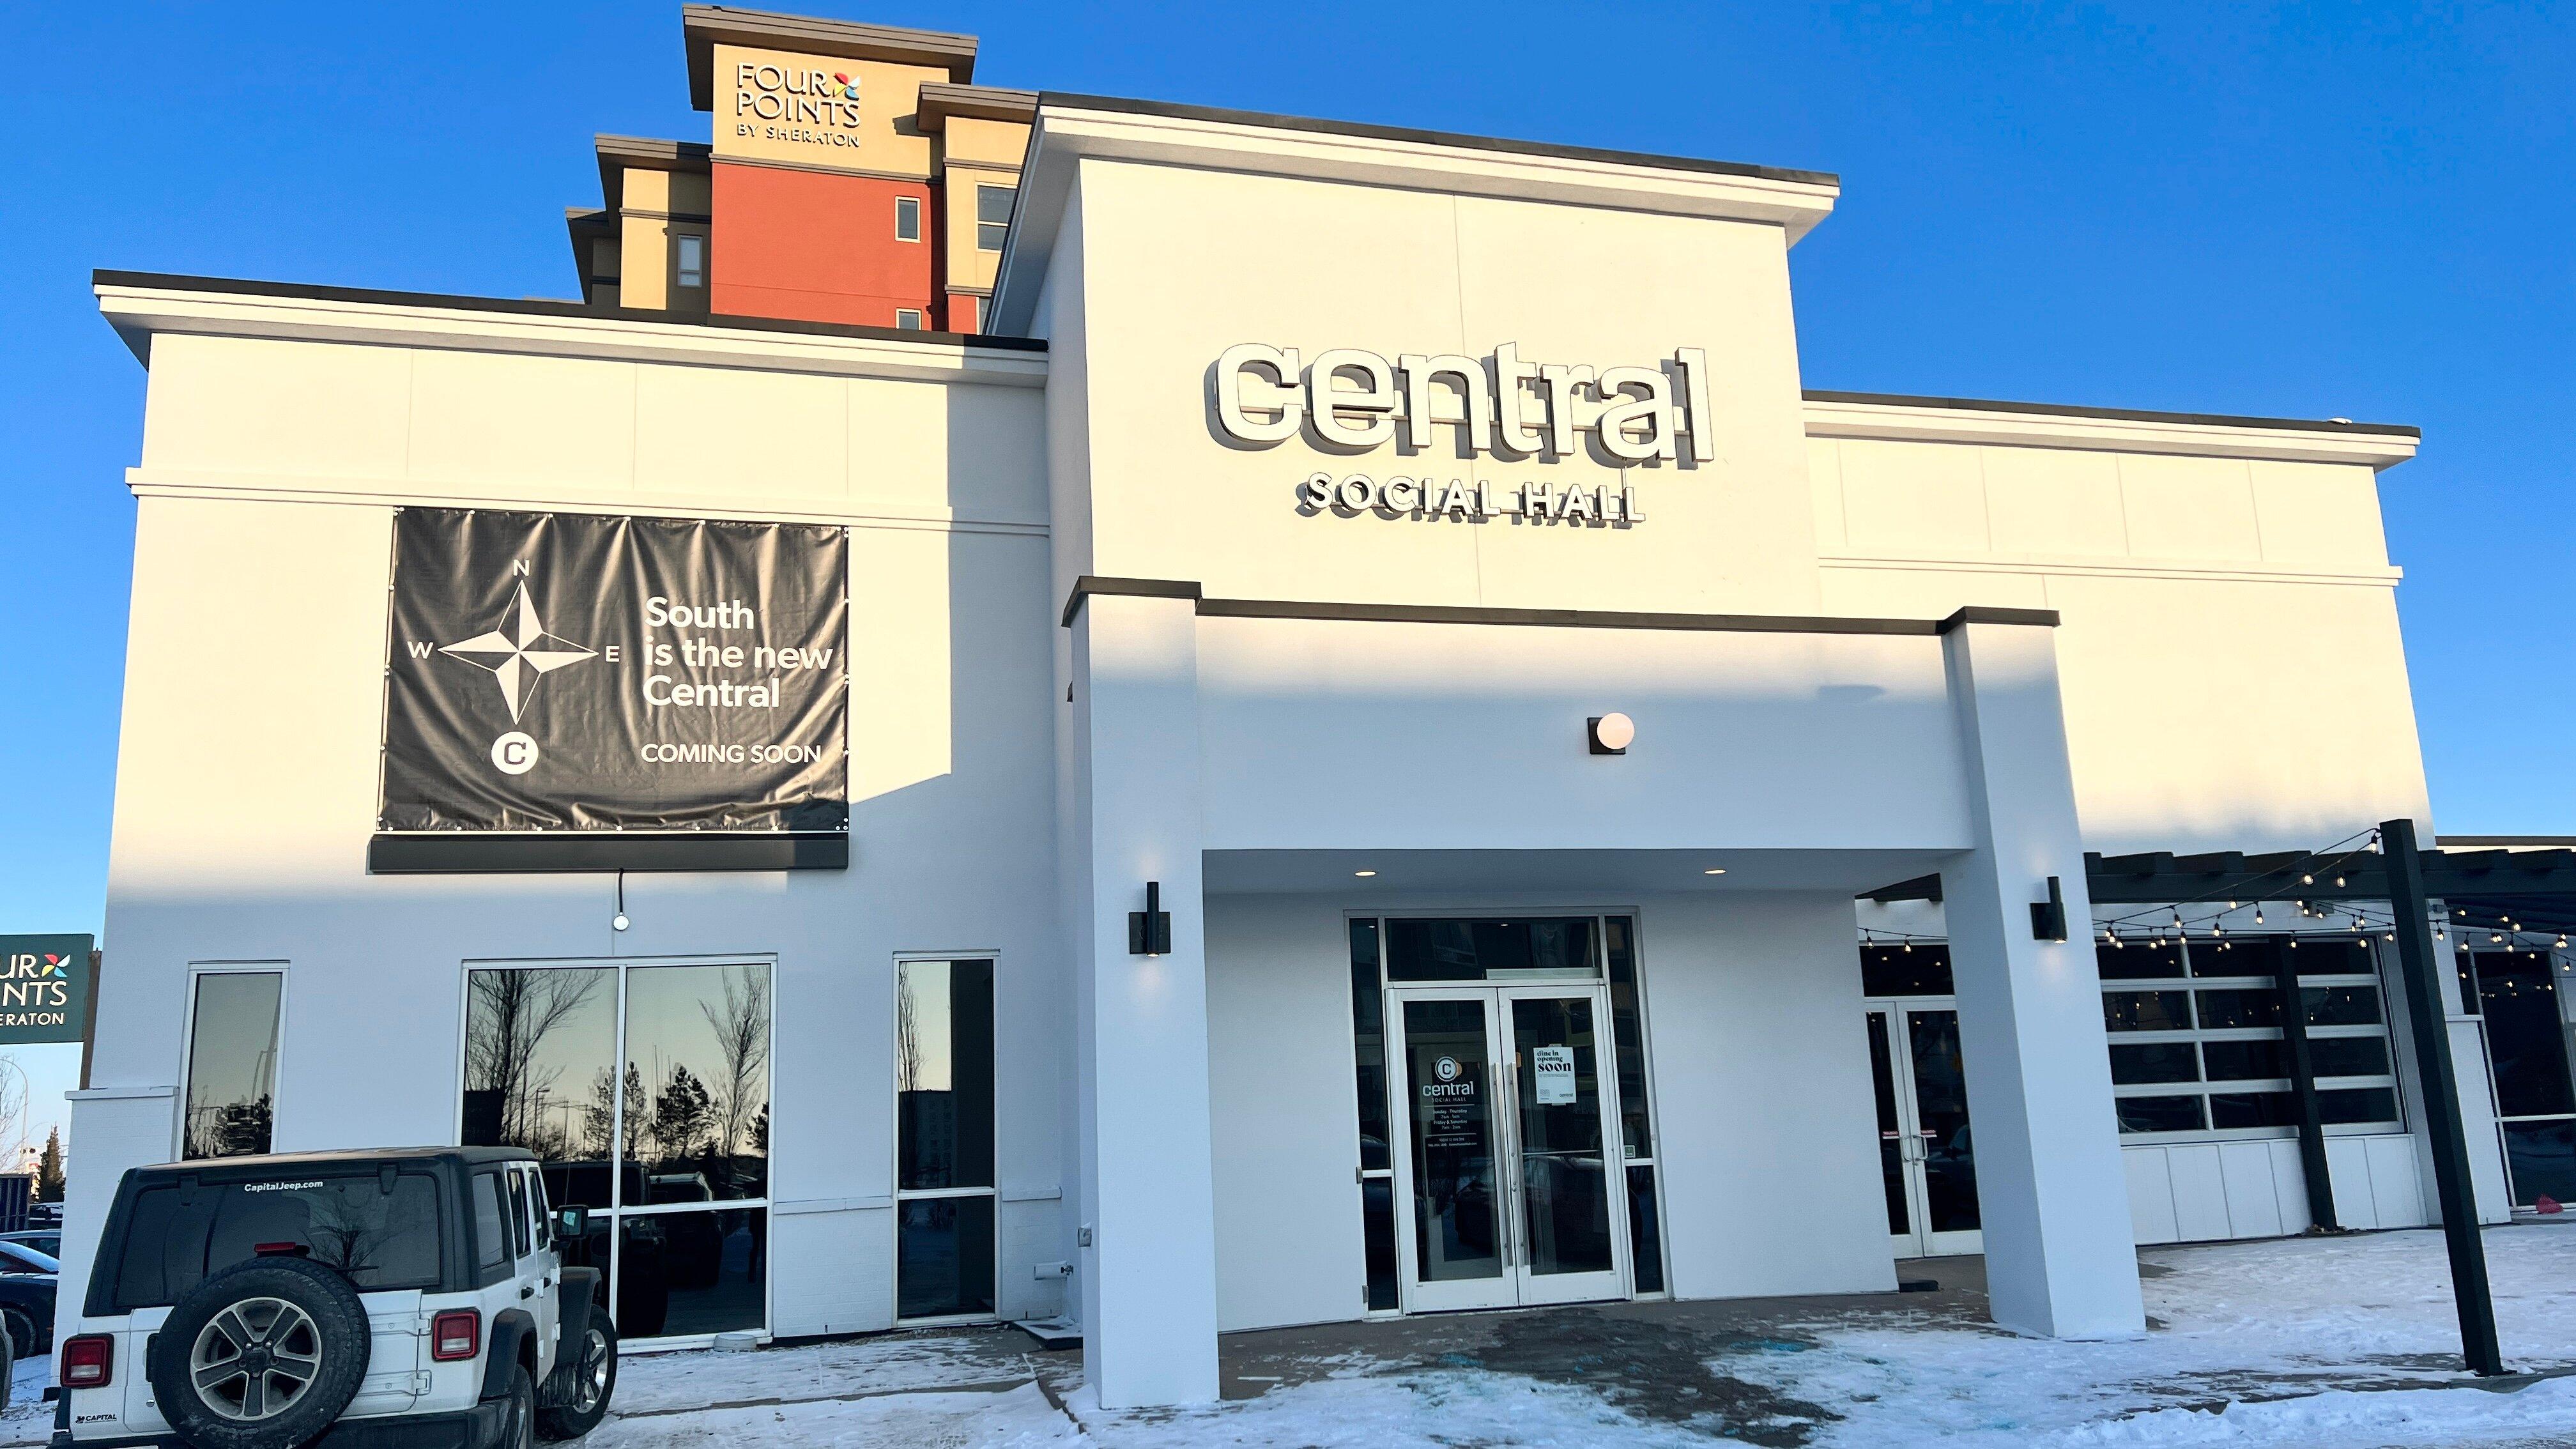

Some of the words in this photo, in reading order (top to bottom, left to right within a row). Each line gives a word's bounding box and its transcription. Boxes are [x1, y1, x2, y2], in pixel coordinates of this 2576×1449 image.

[737, 62, 831, 97] FOUR
[737, 90, 860, 128] POINTS
[737, 123, 759, 137] BY
[767, 126, 859, 147] SHERATON
[1216, 342, 1715, 463] central
[1306, 472, 1501, 516] SOCIAL
[1521, 481, 1646, 523] HALL
[513, 559, 530, 576] N
[644, 596, 755, 630] South
[407, 641, 434, 659] W
[605, 645, 620, 663] E
[645, 635, 673, 666] is
[681, 637, 744, 668] the
[755, 645, 833, 670] new
[642, 675, 779, 707] Central
[640, 743, 745, 763] COMING
[750, 744, 822, 763] SOON
[1538, 1062, 1572, 1072] soon
[1422, 1080, 1475, 1096] central
[244, 1181, 323, 1193] CapitalJeep.com
